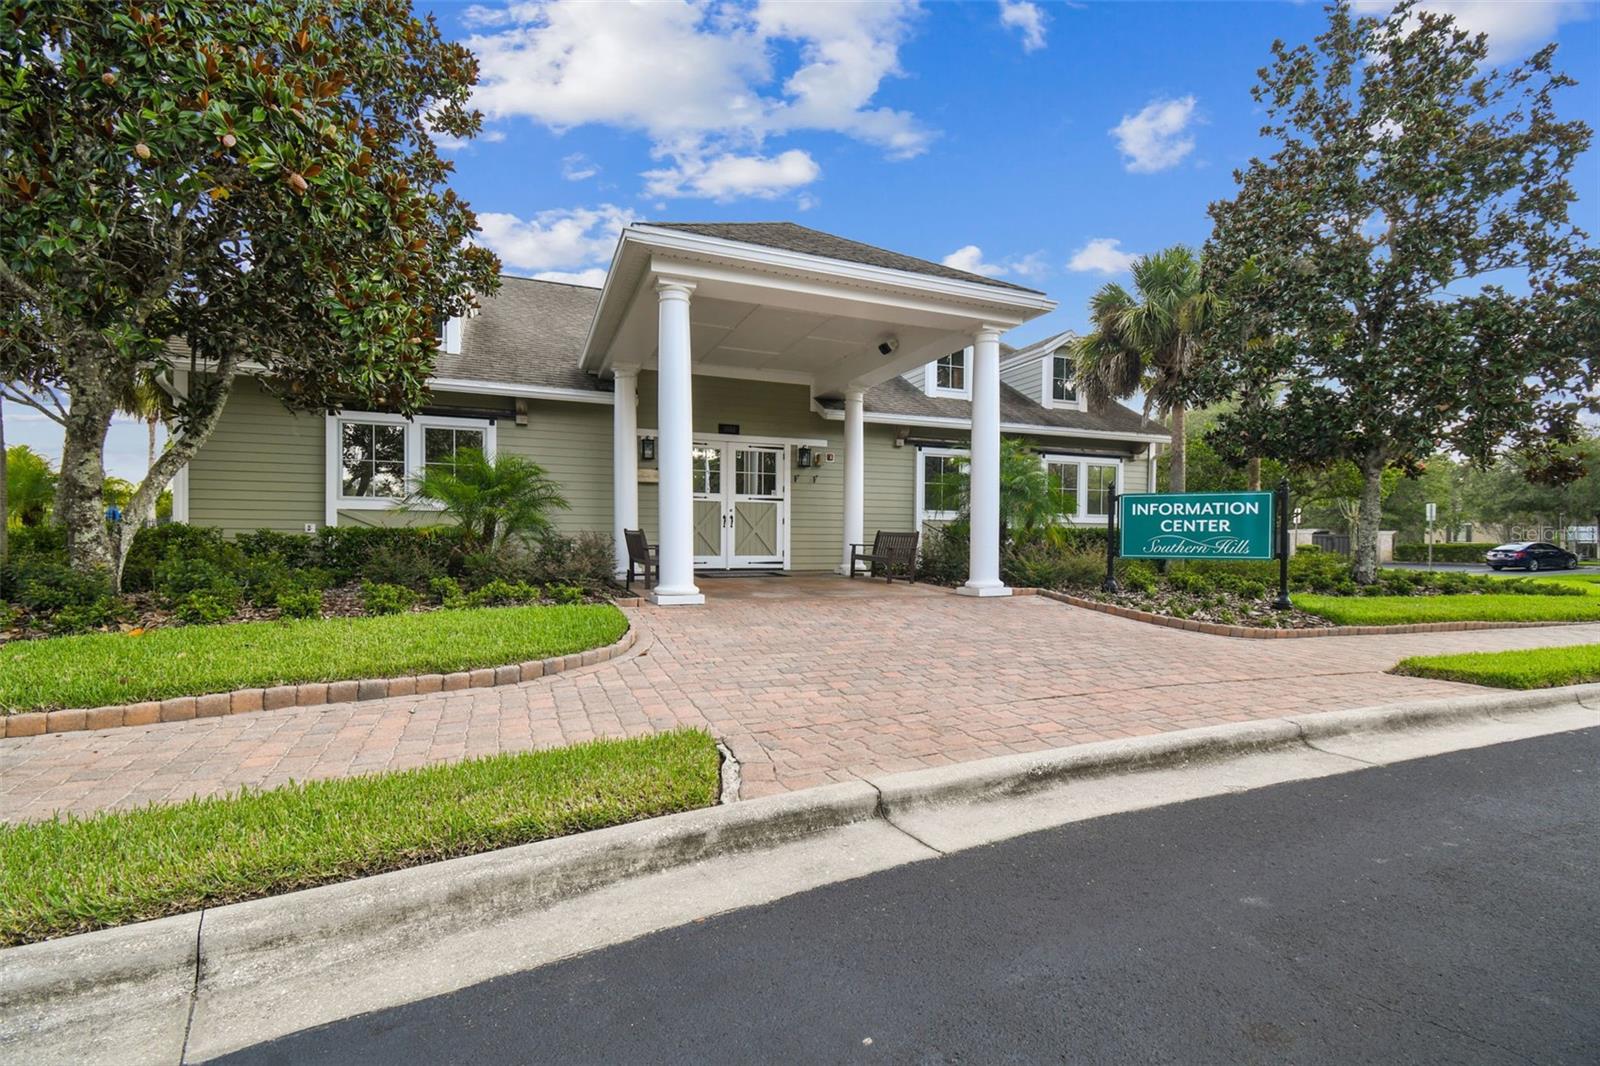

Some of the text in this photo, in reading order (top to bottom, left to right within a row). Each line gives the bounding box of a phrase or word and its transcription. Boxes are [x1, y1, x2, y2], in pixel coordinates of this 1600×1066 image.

[1132, 502, 1259, 516] INFORMATION
[1160, 519, 1231, 532] CENTER
[1143, 539, 1250, 554] Southern Hills
